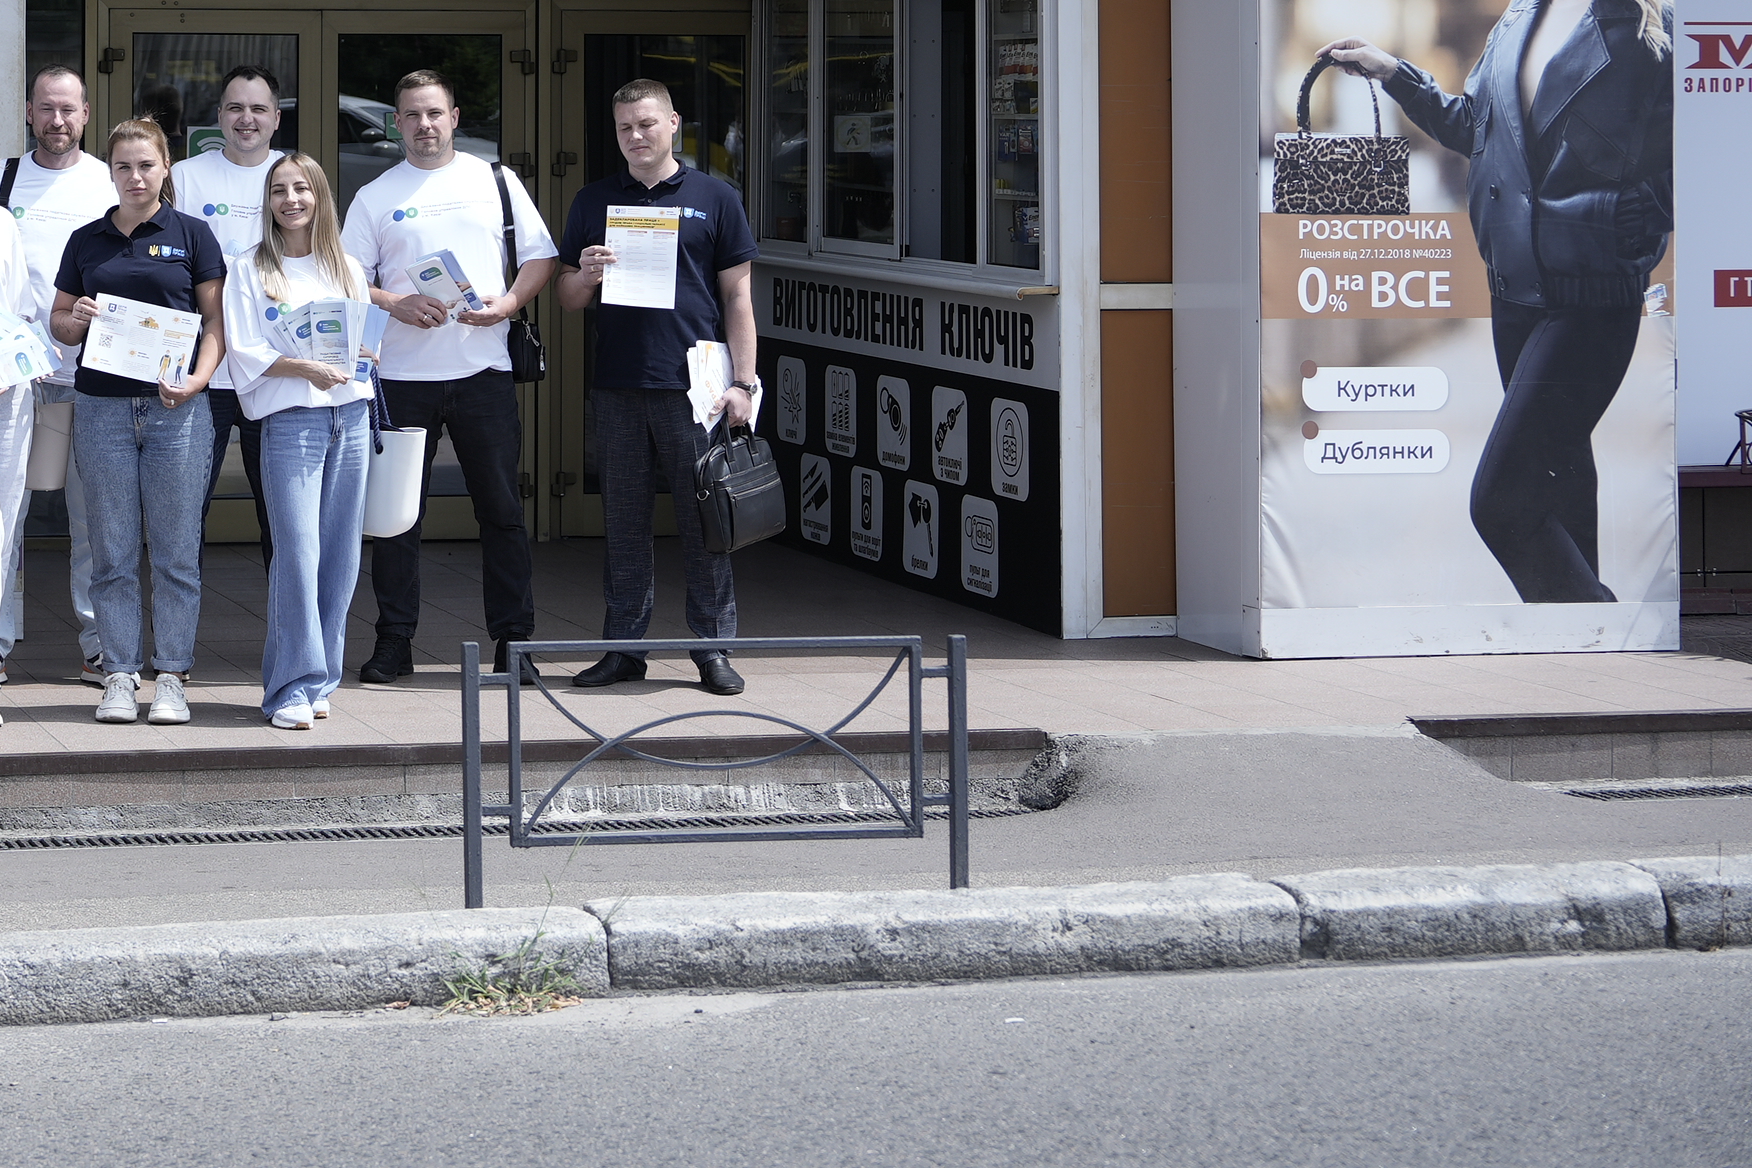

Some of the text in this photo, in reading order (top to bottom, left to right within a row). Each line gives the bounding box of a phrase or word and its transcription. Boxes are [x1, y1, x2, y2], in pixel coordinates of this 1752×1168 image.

[1299, 220, 1452, 240] РОЗСТРОЧКА
[1299, 249, 1453, 260] Ліцензія від 27.12.2018 №40223
[1335, 274, 1365, 291] на
[1371, 271, 1452, 308] ВСЕ
[772, 277, 1035, 371] ВИГОТОВЛЕННЯ КЛЮЧІВ
[1338, 380, 1416, 402] Куртки
[1321, 441, 1433, 464] Дублянки
